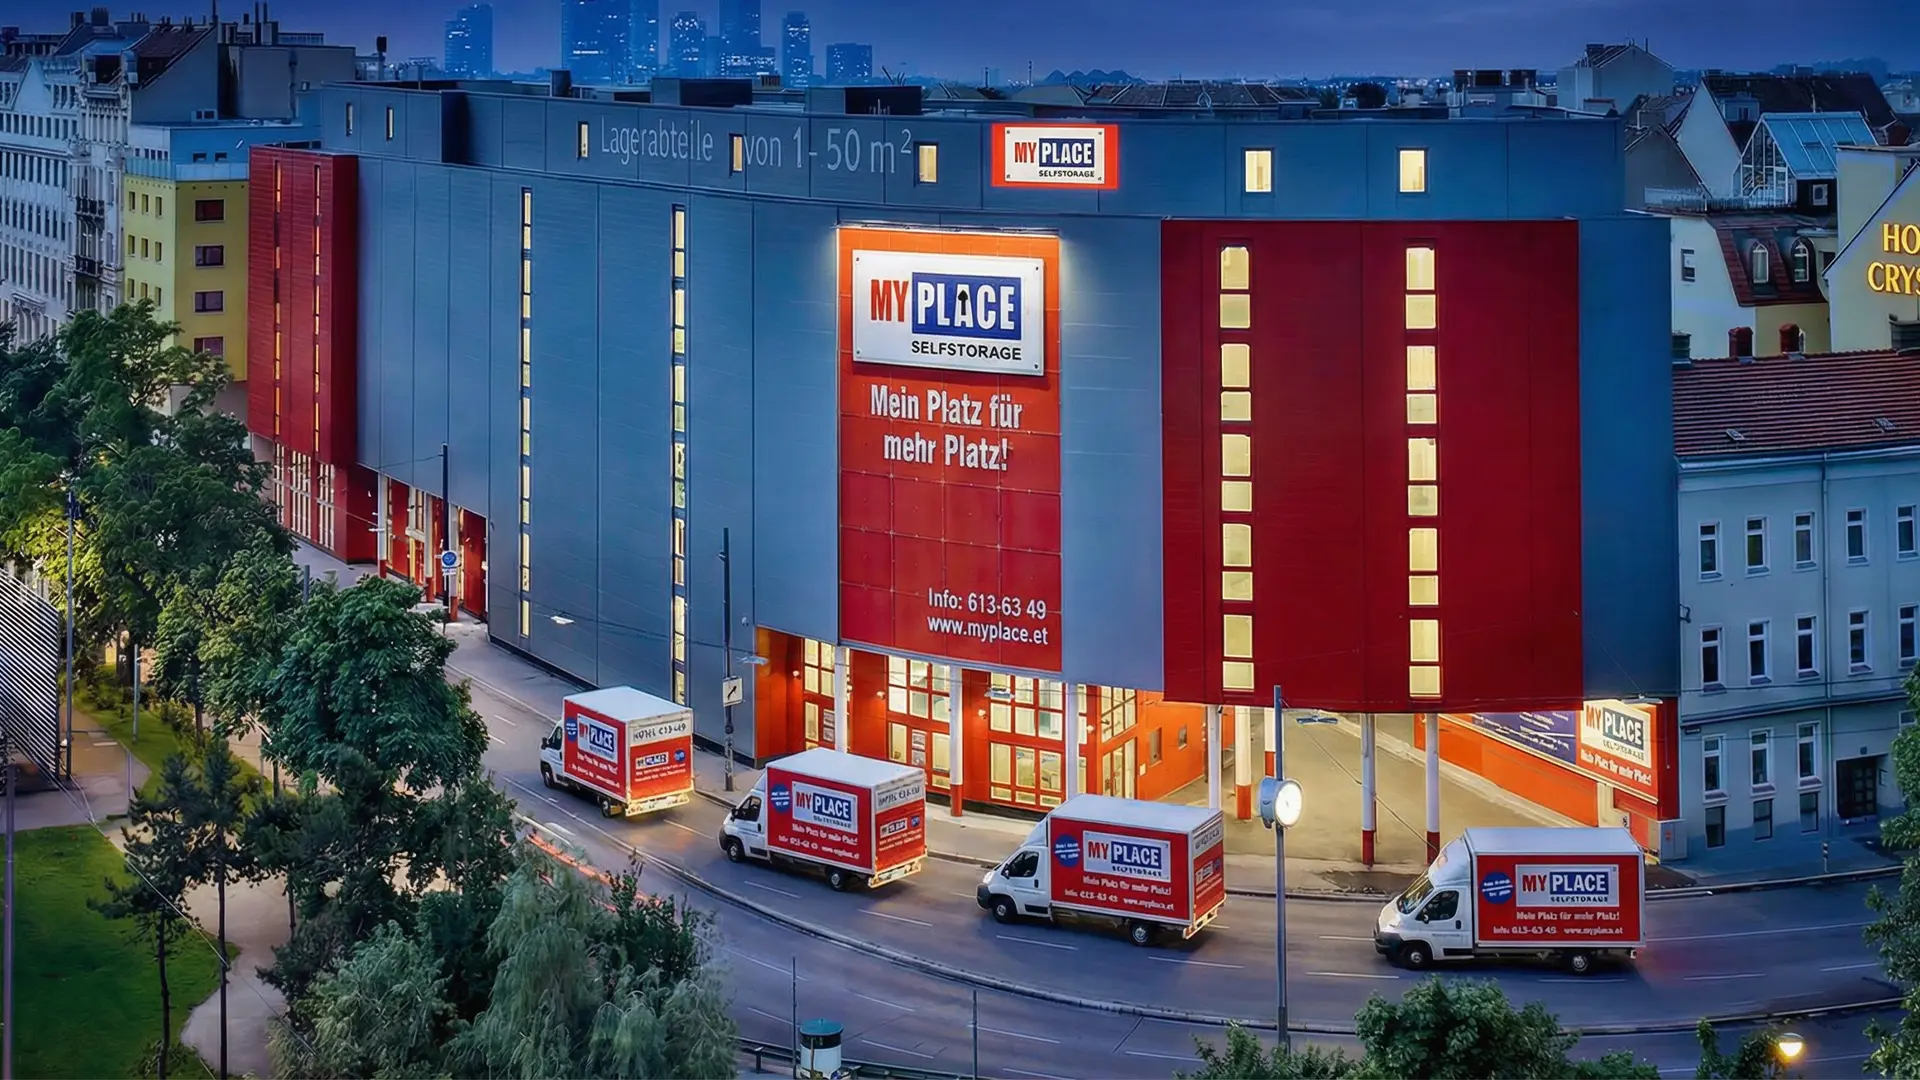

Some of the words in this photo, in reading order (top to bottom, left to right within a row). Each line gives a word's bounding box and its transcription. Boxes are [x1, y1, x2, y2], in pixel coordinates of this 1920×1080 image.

[601, 116, 713, 165] Lagerabteile
[744, 134, 782, 167] von
[1014, 142, 1037, 163] MY
[1041, 142, 1092, 164] PLACE
[1039, 170, 1094, 178] SELFSTORAGE
[870, 279, 909, 322] MY
[917, 281, 1015, 330] PLACE
[911, 340, 1022, 361] SELFSTORAGE
[871, 384, 920, 420] Mein
[927, 389, 983, 426] Platz
[989, 394, 1022, 428] für
[884, 431, 936, 464] mehr
[944, 434, 1008, 471] Platz!
[928, 587, 963, 610] Info:
[968, 592, 1022, 617] 613-63
[1026, 599, 1047, 620] 49
[1586, 704, 1601, 730] MY
[1604, 711, 1642, 745] PLACE
[796, 791, 812, 810] MY
[814, 796, 850, 819] PLACE
[1088, 841, 1109, 860] MY
[1113, 844, 1159, 866] PLACE
[1522, 874, 1547, 892] MY
[1552, 874, 1606, 892] PLACE
